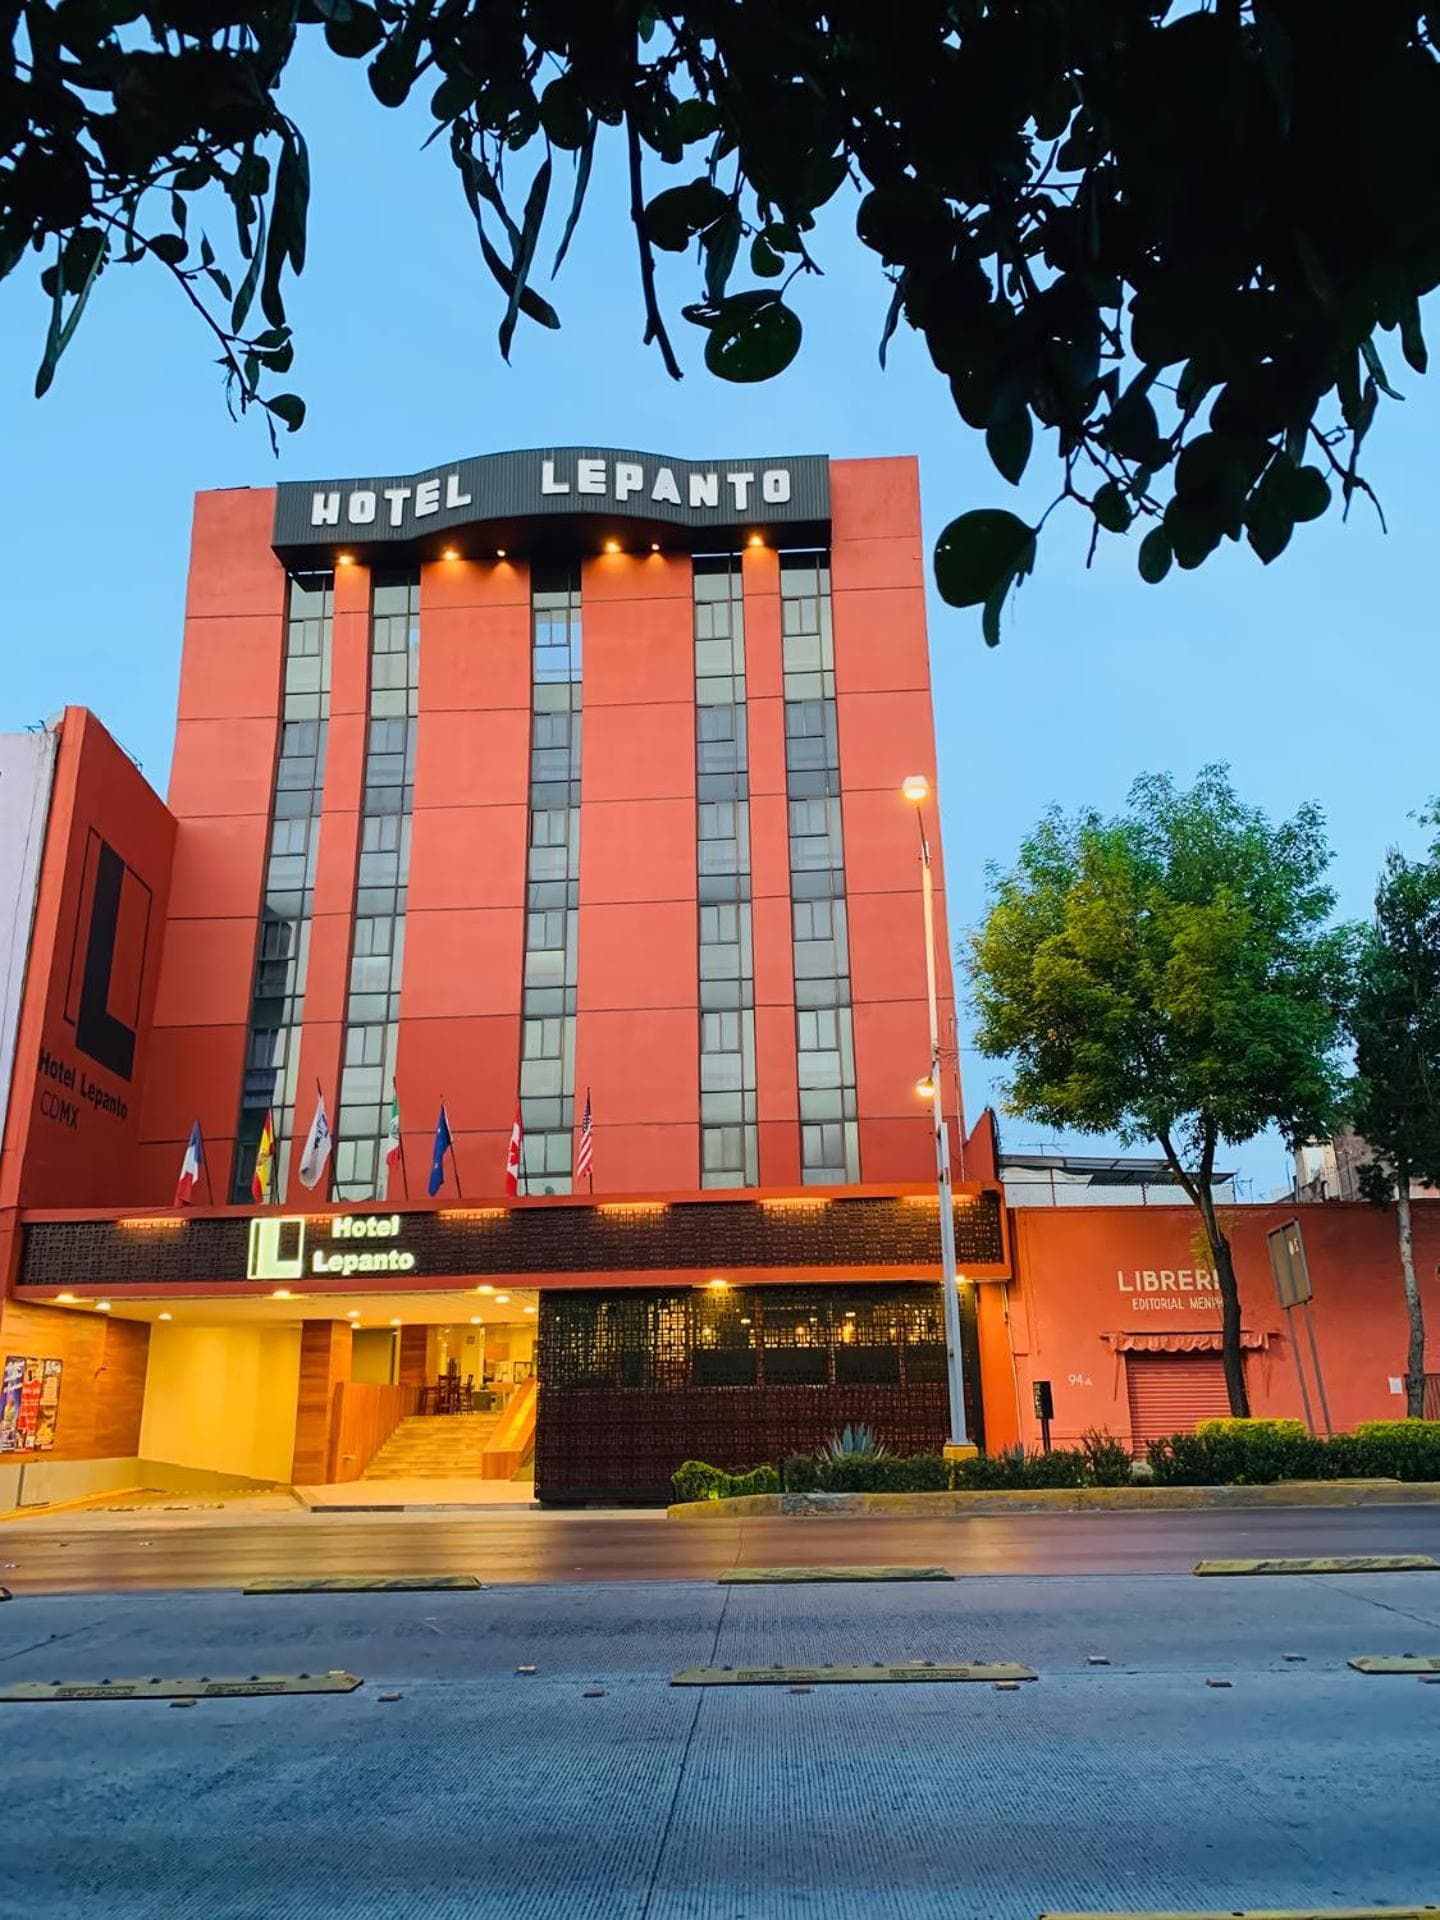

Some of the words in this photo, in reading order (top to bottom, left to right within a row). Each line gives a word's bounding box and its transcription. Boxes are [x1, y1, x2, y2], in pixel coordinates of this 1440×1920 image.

[311, 474, 472, 526] HOTEL
[542, 458, 791, 511] LEPANTO
[38, 1048, 76, 1090] Hotel
[80, 1074, 128, 1120] Lepanto
[40, 1091, 79, 1130] CDMX
[331, 1215, 400, 1239] Hotel
[312, 1250, 415, 1276] Lepanto
[1117, 1269, 1221, 1292] LIBRERI
[1132, 1297, 1185, 1311] EDITORIAL
